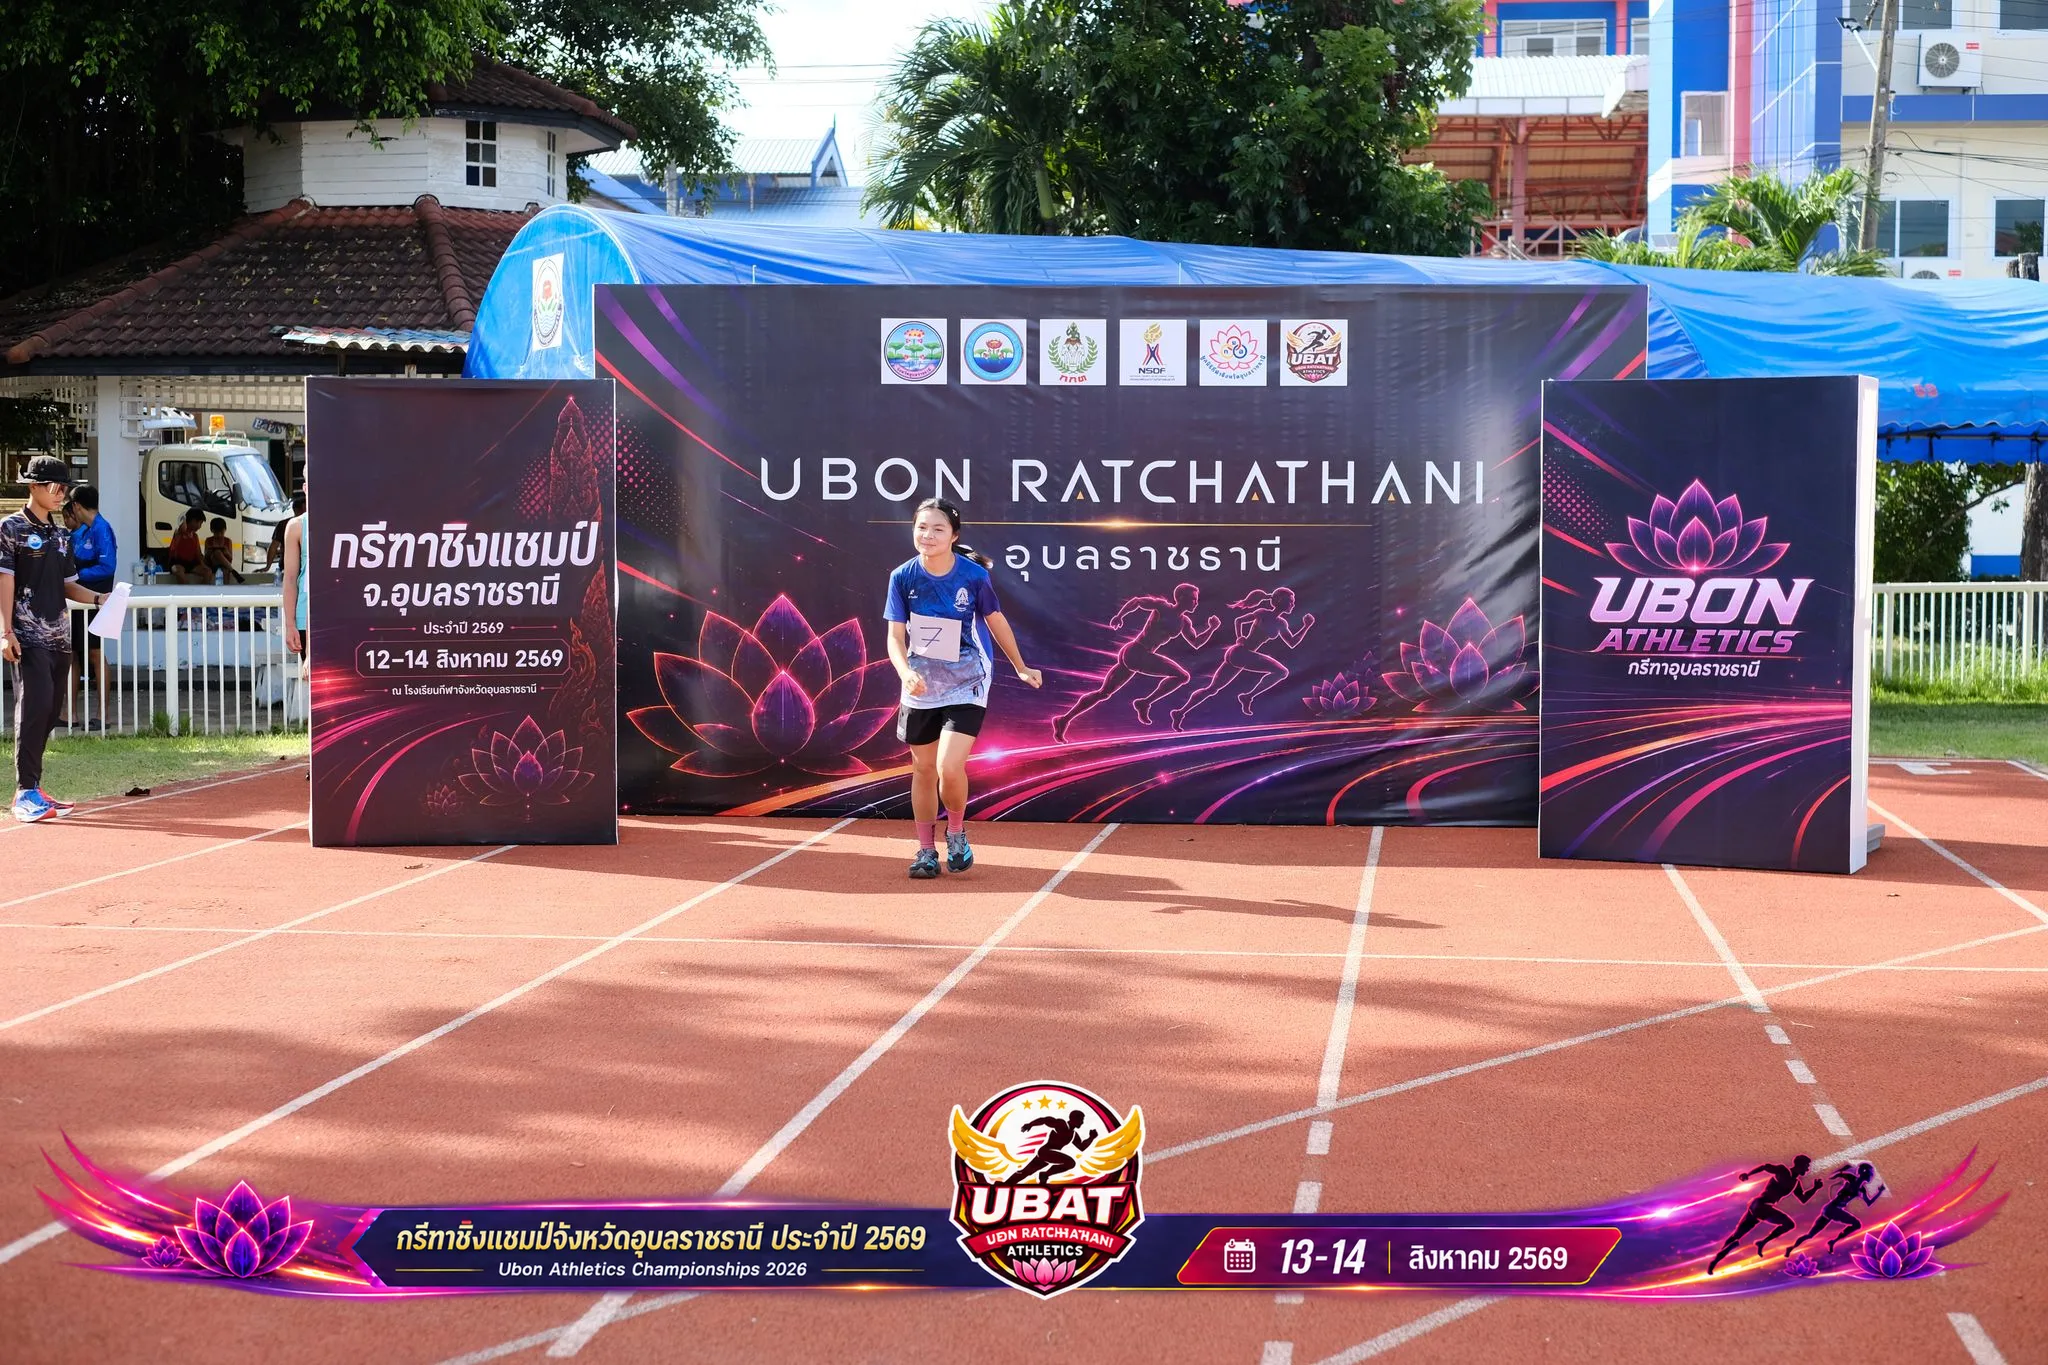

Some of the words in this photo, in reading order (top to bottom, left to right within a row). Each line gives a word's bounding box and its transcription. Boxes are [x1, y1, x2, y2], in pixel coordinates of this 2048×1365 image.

[1290, 353, 1338, 365] UBAT
[761, 457, 971, 502] UBON
[1012, 459, 1484, 505] RATCHATHANI
[330, 520, 599, 569] กรีฑาชิงแชมป์
[363, 573, 560, 616] จ.อุบลราชธานี
[1589, 577, 1816, 625] UBON
[423, 621, 469, 635] ประจำปี
[472, 622, 504, 634] 2569
[920, 626, 943, 648] 7
[1588, 628, 1805, 653] ATHLETICS
[436, 649, 508, 669] สิงหาคม
[515, 649, 563, 668] 2569
[1628, 658, 1761, 681] กรีฑาอุบลราชธานี
[404, 683, 537, 697] โรงเรียนกีฬาจังหวัดอุบลราชธานี
